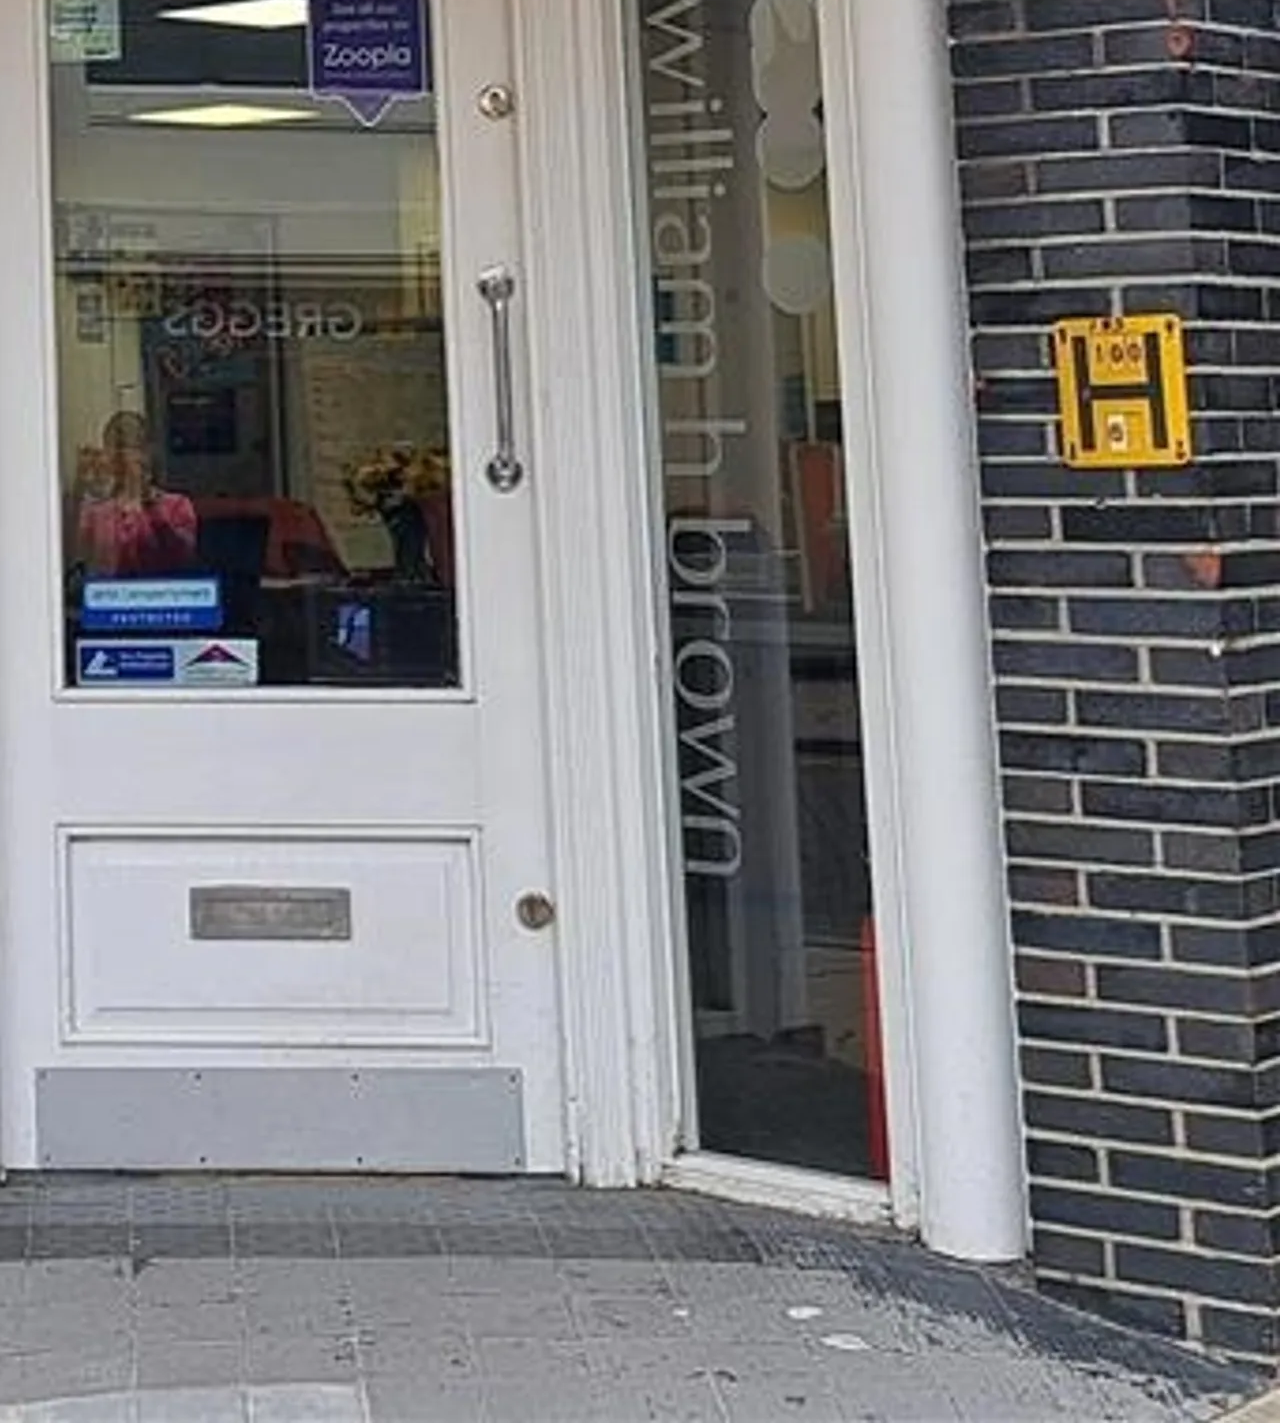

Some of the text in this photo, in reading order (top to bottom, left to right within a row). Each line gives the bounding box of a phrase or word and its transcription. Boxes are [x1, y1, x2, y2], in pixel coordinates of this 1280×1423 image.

[323, 42, 412, 70] Zoopla
[1071, 332, 1169, 453] H
[665, 418, 746, 476] h
[670, 519, 752, 876] brown
